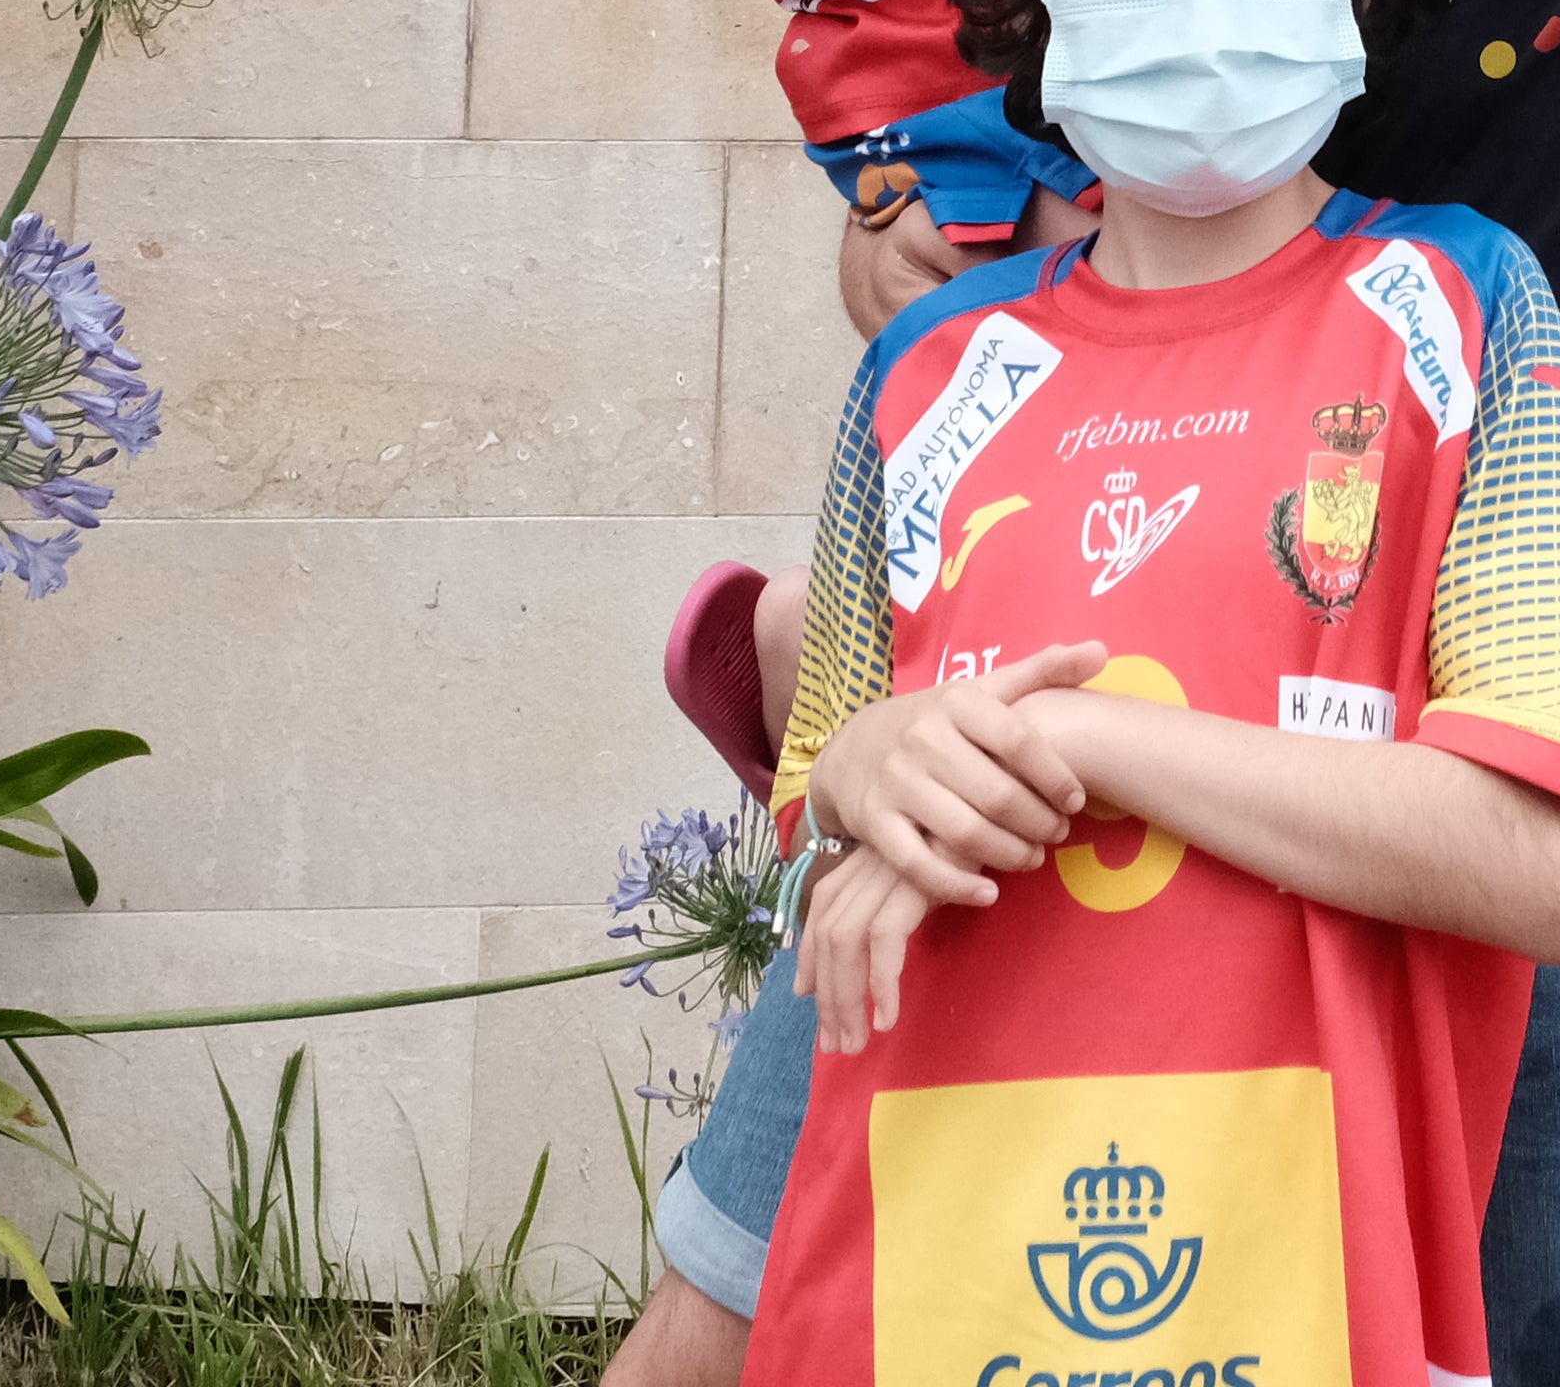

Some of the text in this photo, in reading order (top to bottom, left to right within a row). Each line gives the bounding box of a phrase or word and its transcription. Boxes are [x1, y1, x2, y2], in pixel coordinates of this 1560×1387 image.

[888, 362, 1042, 580] MELILLA
[918, 338, 1005, 472] AUTÓNOMA
[1055, 409, 1250, 463] rfebm.com
